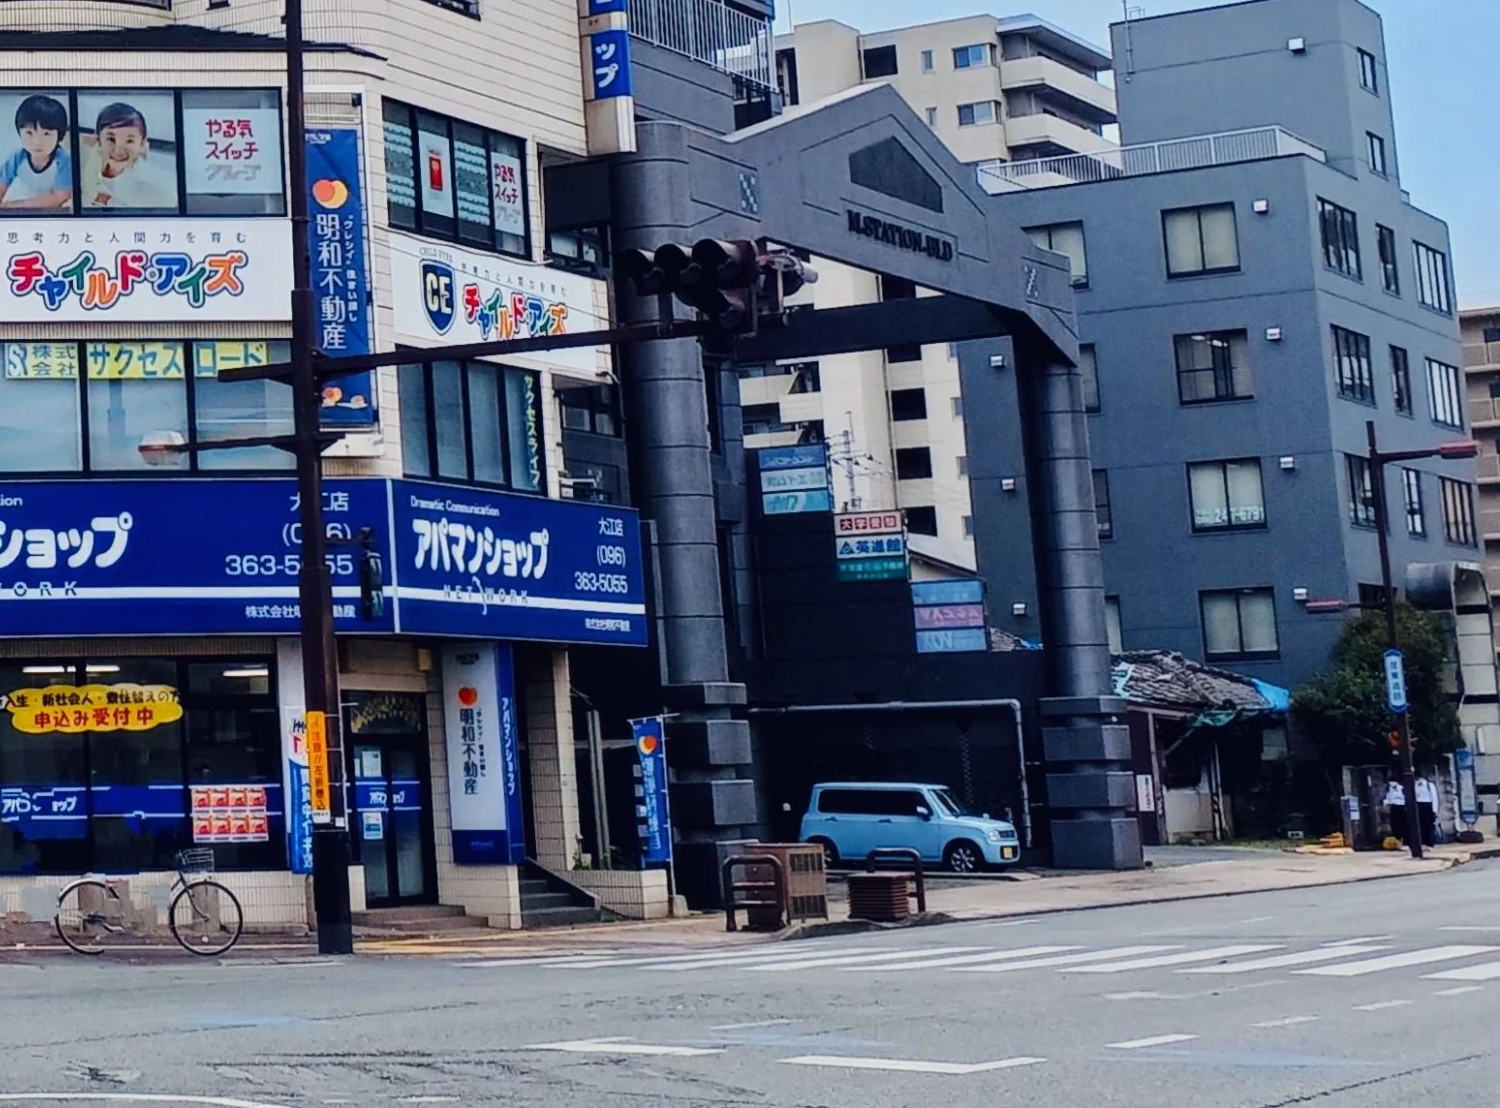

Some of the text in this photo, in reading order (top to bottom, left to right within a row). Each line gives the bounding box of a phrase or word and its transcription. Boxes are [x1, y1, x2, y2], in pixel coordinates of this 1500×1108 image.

[205, 118, 254, 139] やる気
[205, 141, 259, 160] スイッチ
[493, 184, 519, 204] スイッチ
[6, 231, 247, 244] 思考力と人間力を育む
[316, 213, 347, 350] 明和不動産
[426, 272, 452, 314] CE
[31, 344, 76, 360] 株式
[31, 361, 76, 377] 会社
[410, 494, 500, 517] Dramatic Communication
[598, 516, 624, 537] 大江店
[412, 516, 550, 580] アパマンショップ
[596, 544, 626, 568] (096)
[855, 537, 903, 553] 英進館
[225, 554, 354, 576] 363-555
[574, 570, 628, 594] 363-5055
[34, 706, 154, 728] 申込み受付中
[459, 708, 479, 796] 明和不動産
[501, 697, 515, 796] アパマンショップ
